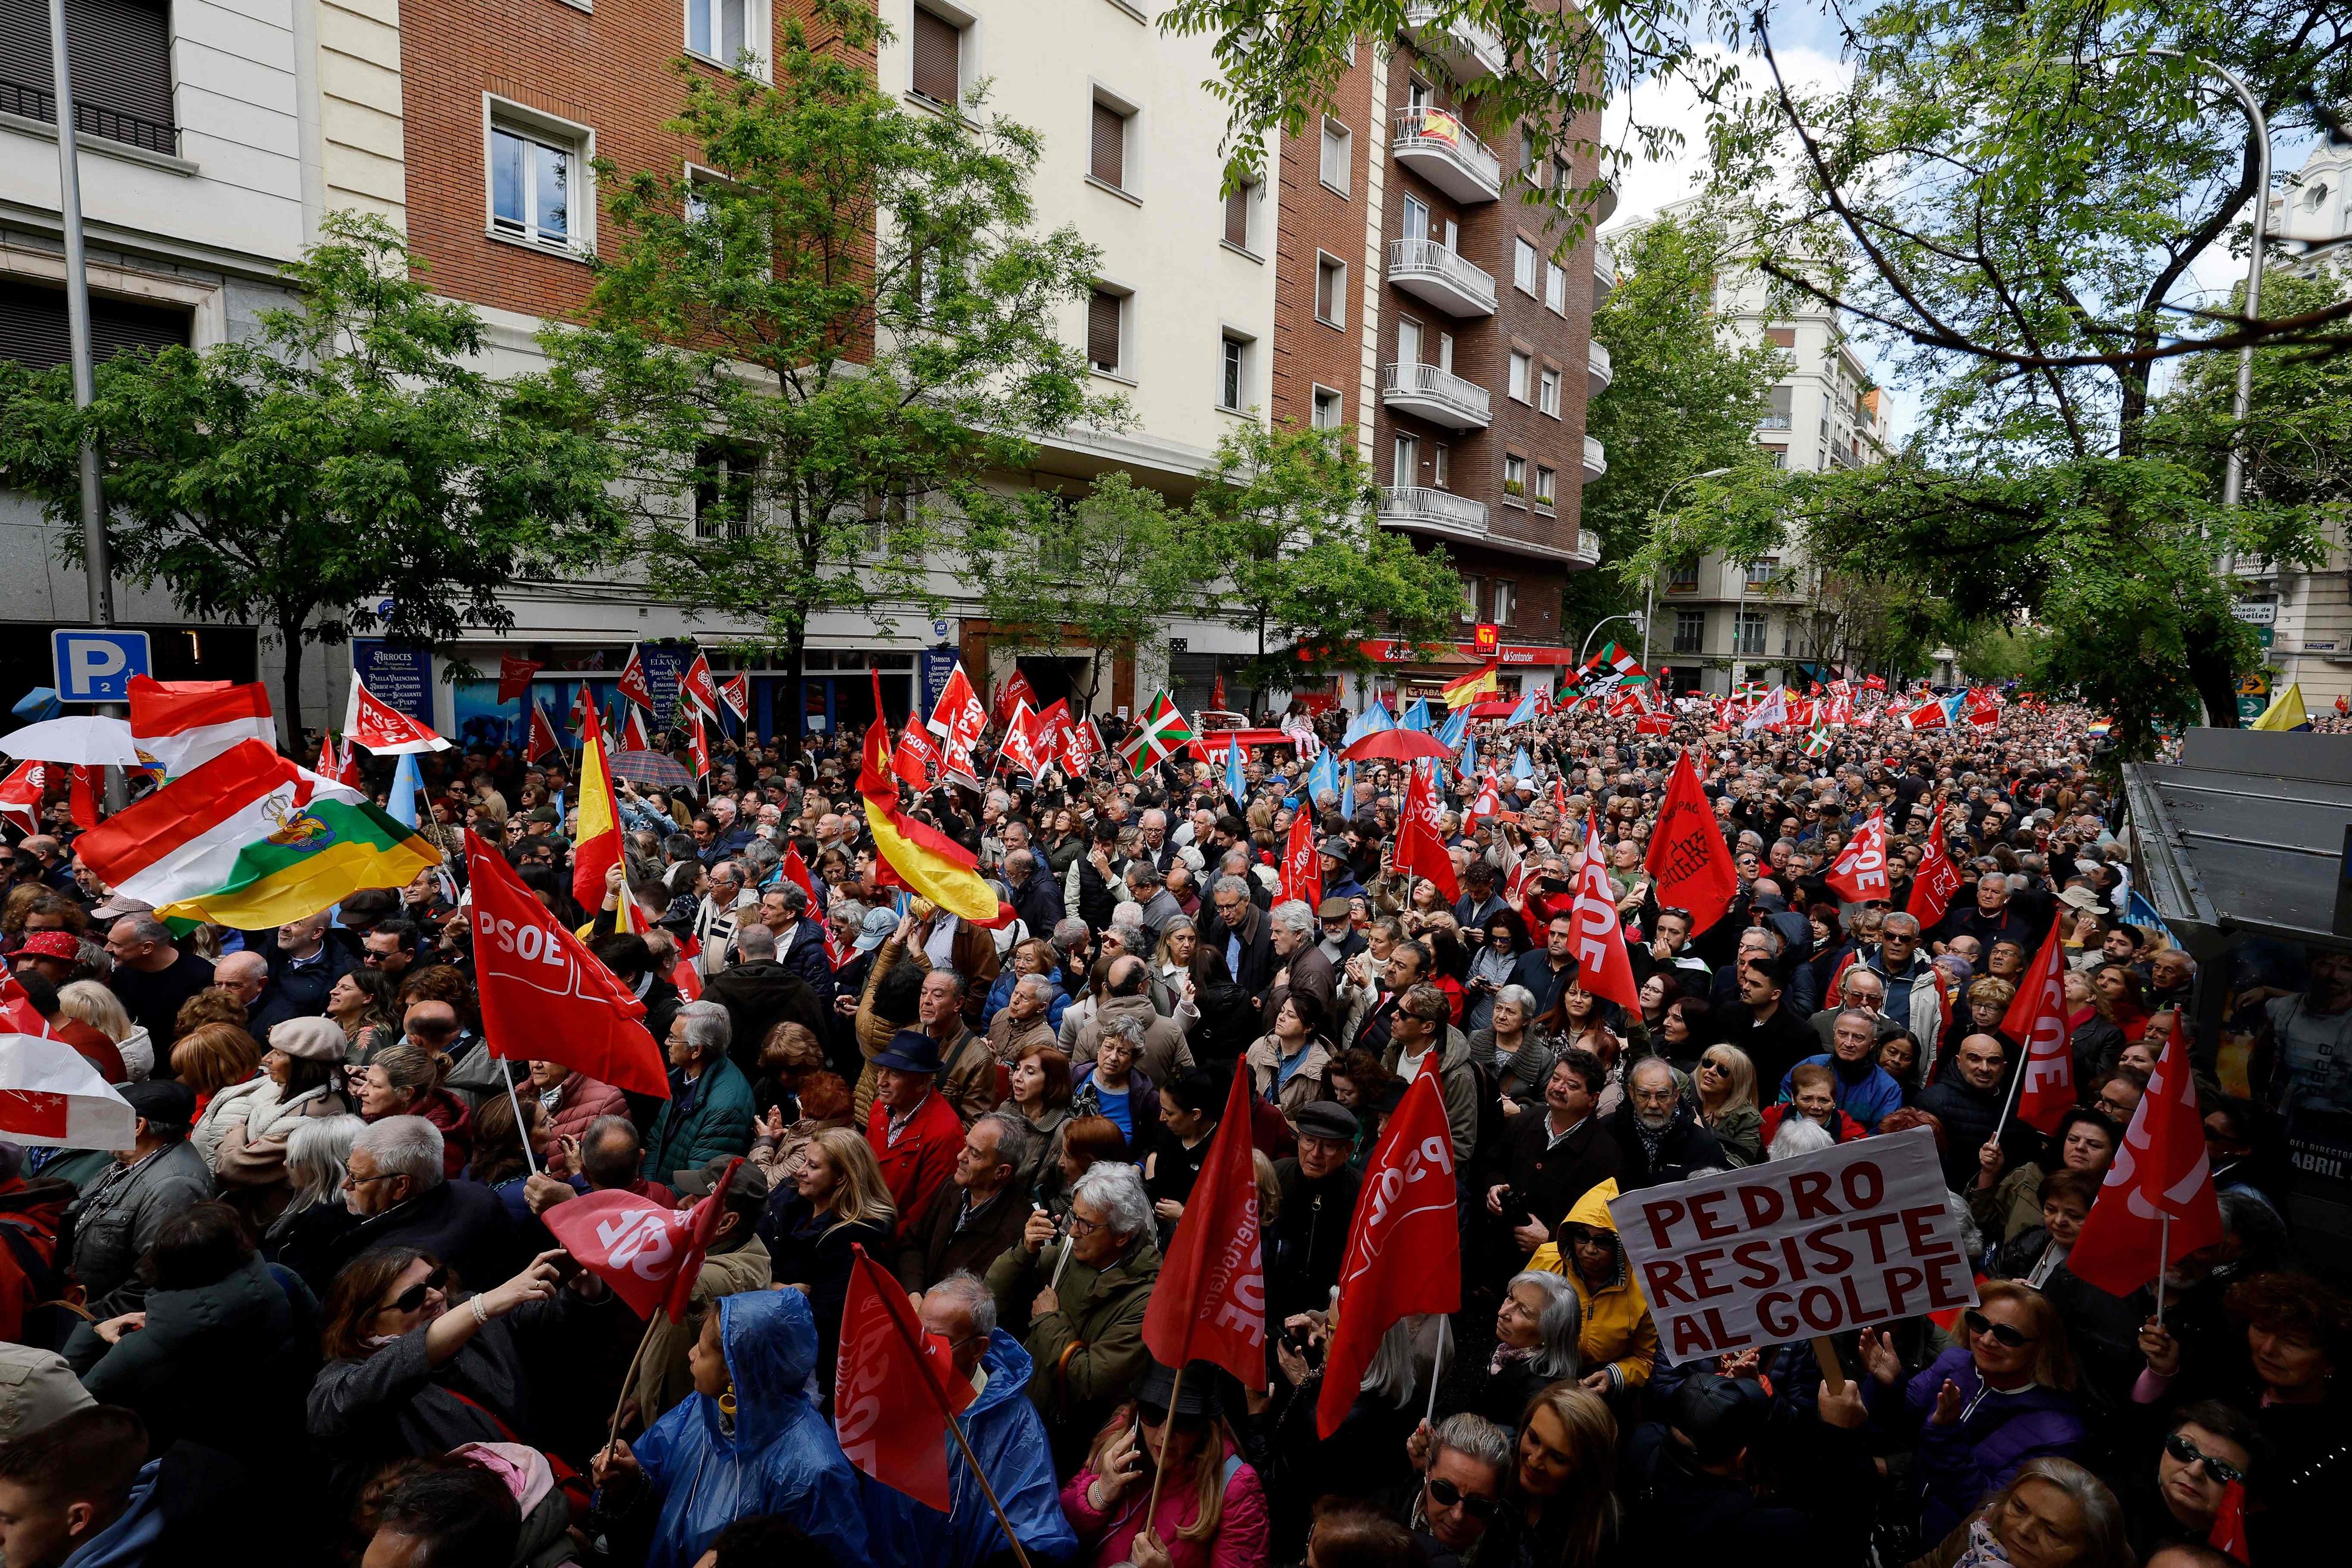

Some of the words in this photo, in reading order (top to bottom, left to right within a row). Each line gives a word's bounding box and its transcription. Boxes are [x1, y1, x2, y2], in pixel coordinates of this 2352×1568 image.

[68, 639, 126, 694] P
[373, 651, 412, 664] ARROCES
[930, 655, 950, 664] MARISCOS
[1509, 651, 1534, 662] Santander
[101, 683, 111, 692] 2
[369, 674, 390, 682] PAELLA
[389, 674, 420, 683] VALENCIANA
[958, 697, 984, 735] PSO
[1978, 721, 1997, 733] SOE
[904, 731, 927, 754] PSOE
[950, 738, 974, 768] PSO
[1007, 728, 1040, 772] PSOE
[1210, 748, 1248, 766] rne
[1856, 816, 1885, 890] PSOE
[479, 911, 564, 967] PSOE
[2290, 1138, 2305, 1149] DEL
[2291, 1151, 2345, 1179] ABRIL
[1642, 1161, 1884, 1249] PEDRO
[1642, 1203, 1953, 1309] RESISTE
[1672, 1308, 1752, 1355] AL
[1755, 1253, 1969, 1338] GOLPE
